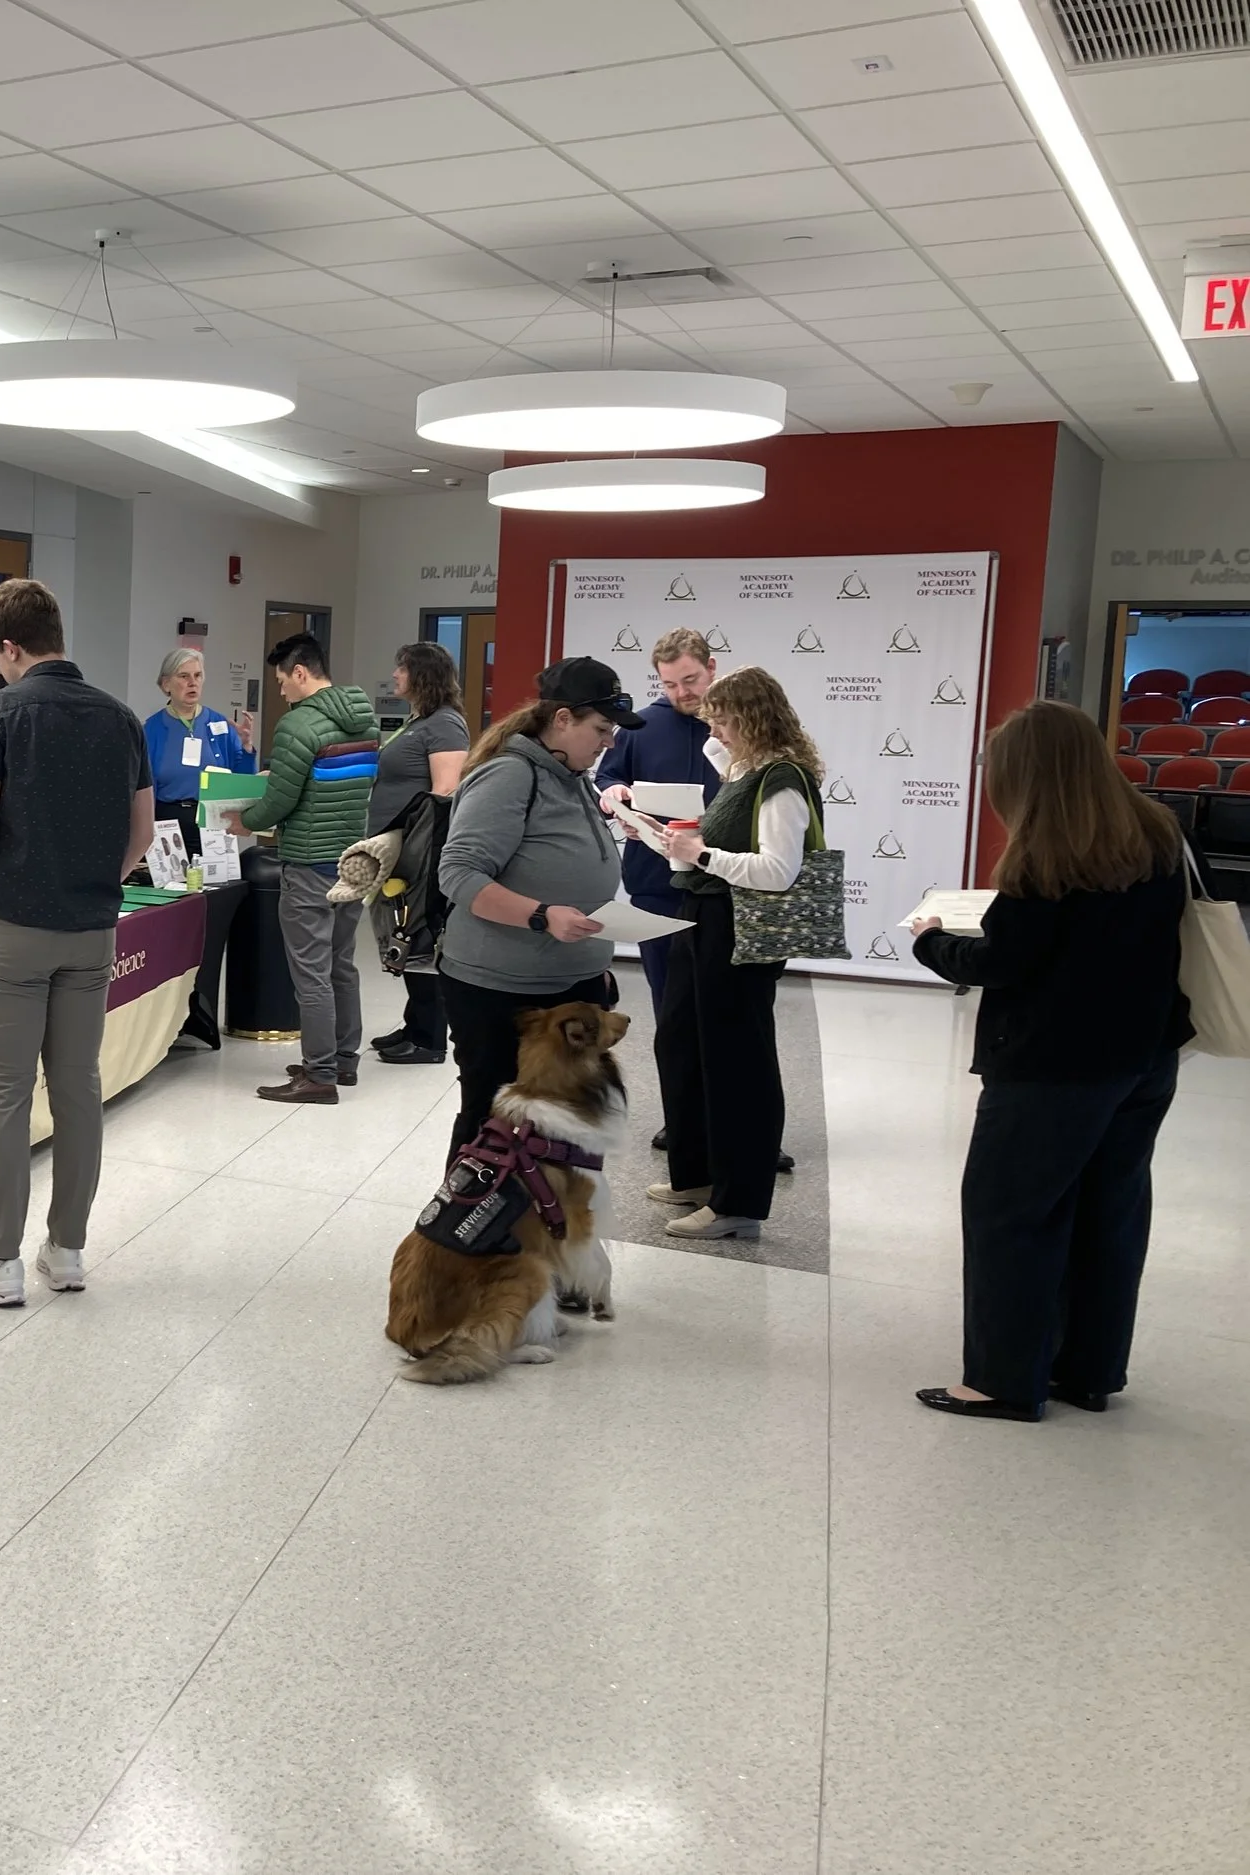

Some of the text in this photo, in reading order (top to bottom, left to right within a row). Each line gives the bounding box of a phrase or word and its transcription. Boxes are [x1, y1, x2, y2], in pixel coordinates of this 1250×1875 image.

[1203, 278, 1250, 332] EX
[420, 563, 497, 580] DR. PHILIP A.
[917, 570, 977, 578] MINNESOTA
[573, 575, 626, 583] MINNESOTA
[739, 574, 794, 582] MINNESOTA
[920, 579, 972, 587] ACADEMY
[753, 591, 794, 599] SCIENCE
[932, 588, 977, 596] SCIENCE
[825, 676, 882, 684] MINNESOTA
[829, 685, 878, 693] ACADEMY
[840, 694, 882, 702] SCIENCE
[901, 780, 961, 790] MINNESOTA
[905, 789, 956, 798] ACADEMY
[901, 798, 961, 807] OF SCIENCE
[110, 950, 146, 982] Science
[454, 1206, 484, 1238] SERVICE
